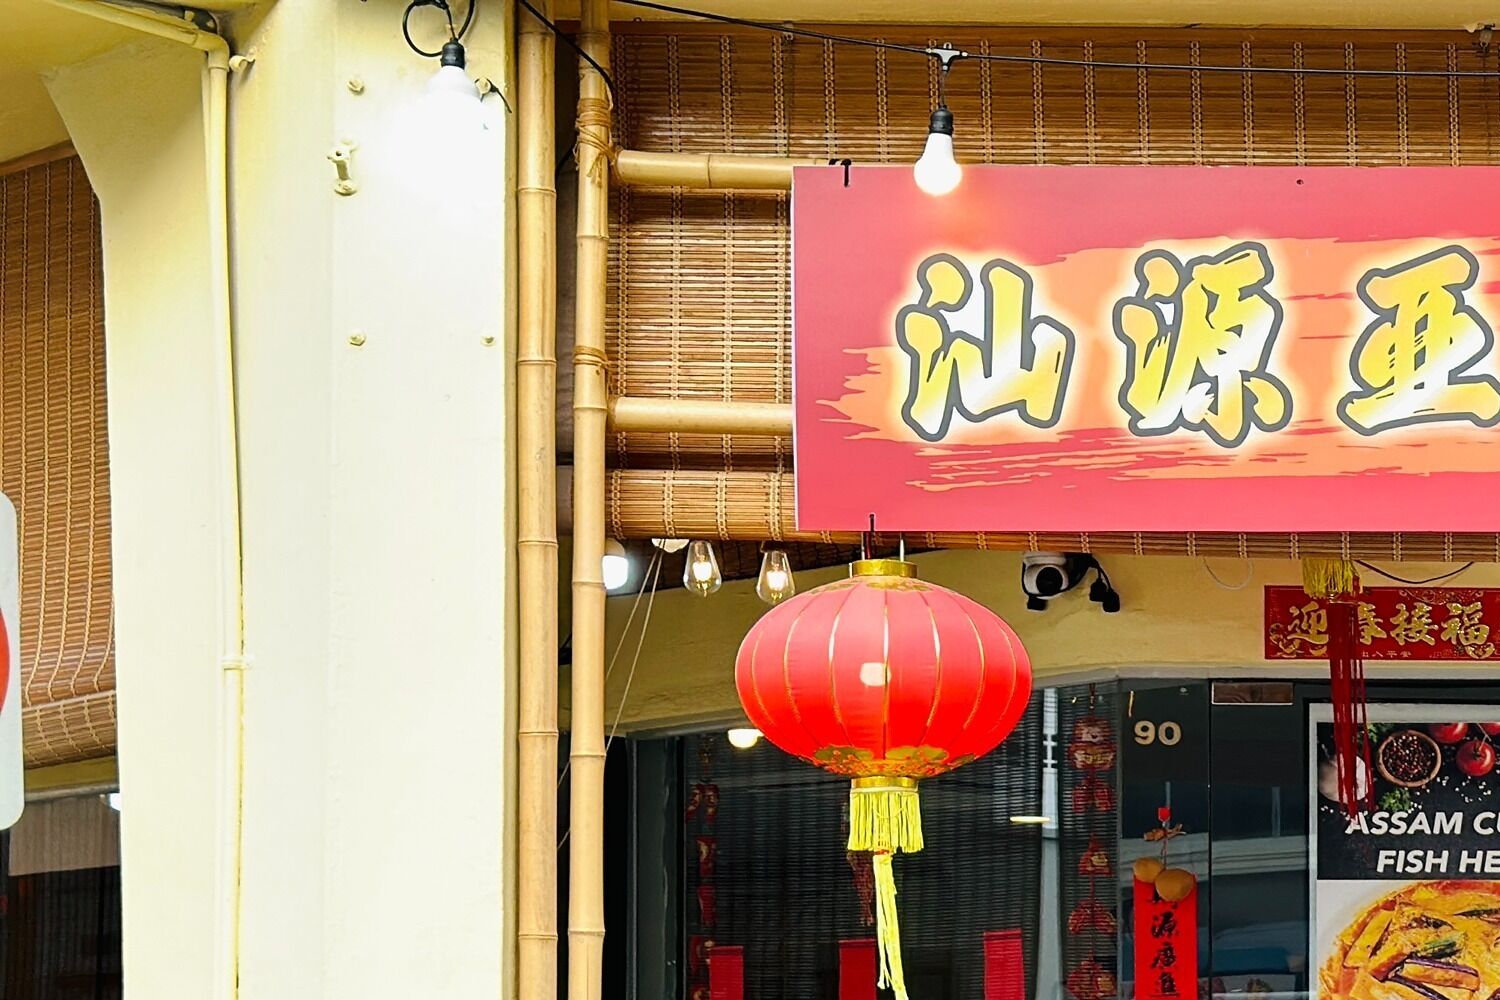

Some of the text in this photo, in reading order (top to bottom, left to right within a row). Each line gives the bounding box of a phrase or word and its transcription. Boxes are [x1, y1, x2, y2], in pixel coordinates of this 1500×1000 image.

[1134, 720, 1182, 746] 90
[1345, 811, 1464, 835] ASSAM
[1376, 850, 1449, 873] FISH
